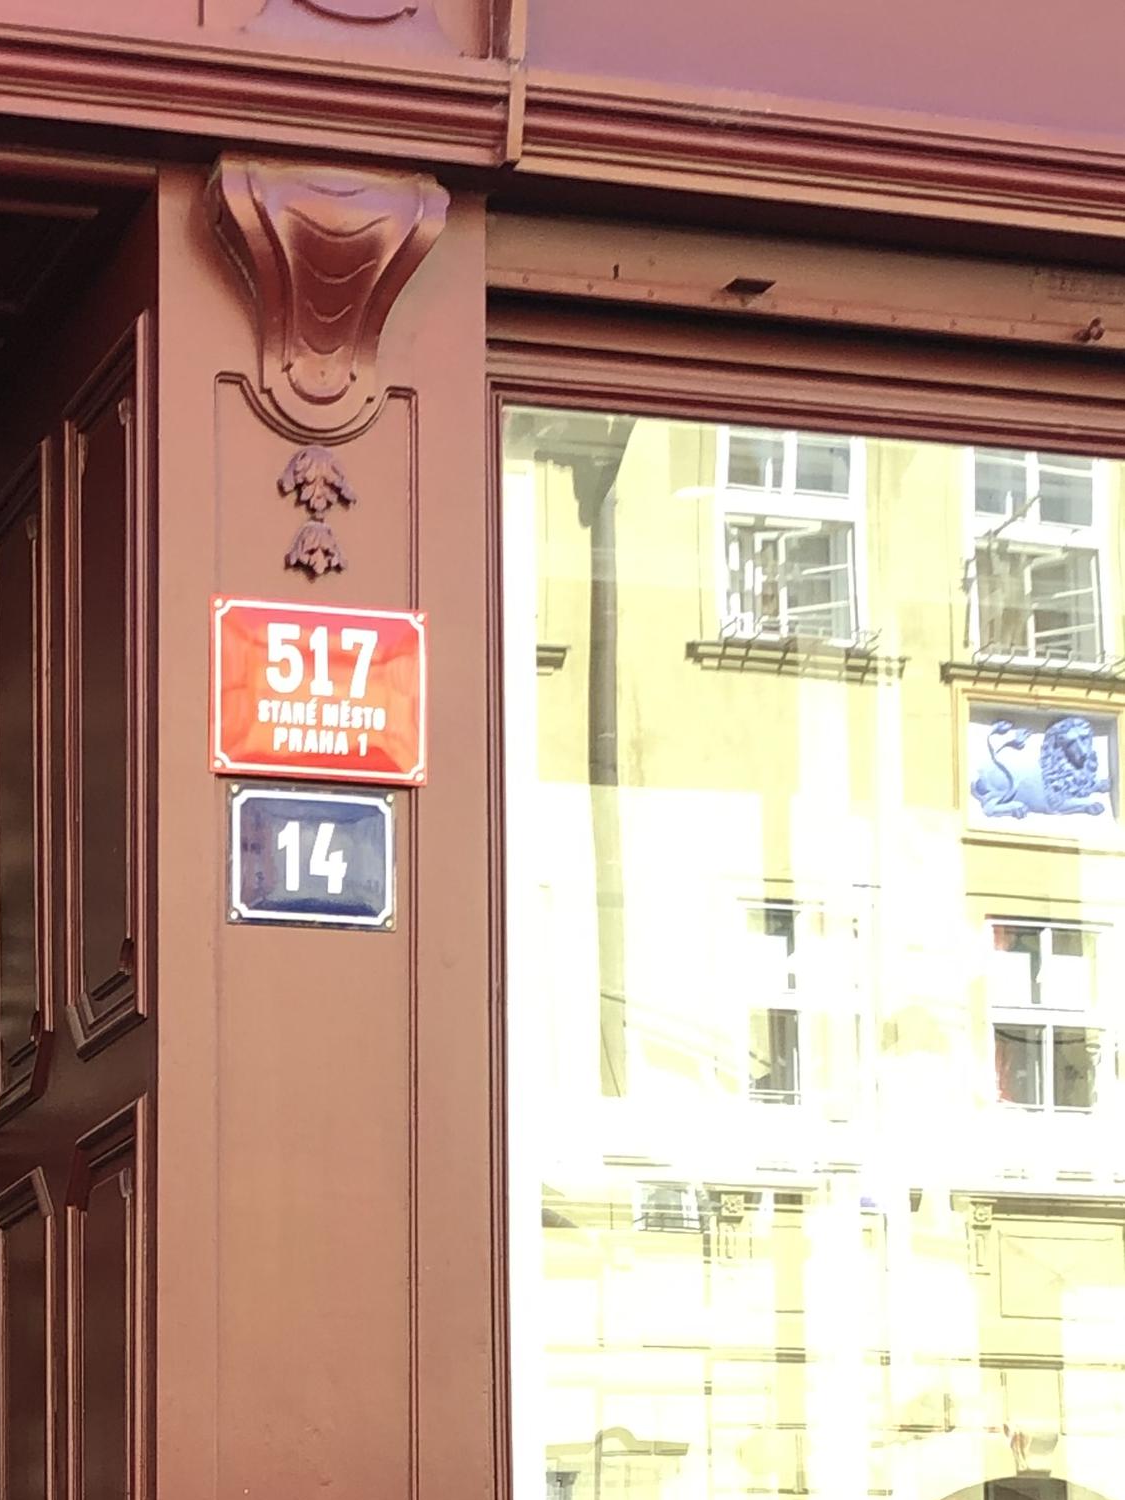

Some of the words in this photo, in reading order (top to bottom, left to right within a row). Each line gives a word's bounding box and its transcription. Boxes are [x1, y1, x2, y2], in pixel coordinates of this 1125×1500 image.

[266, 622, 378, 699] 517
[257, 697, 318, 726] STARÉ
[320, 699, 386, 731] MĚSTO
[273, 727, 349, 755] PRAHA
[357, 733, 368, 756] 1
[277, 821, 348, 894] 14
